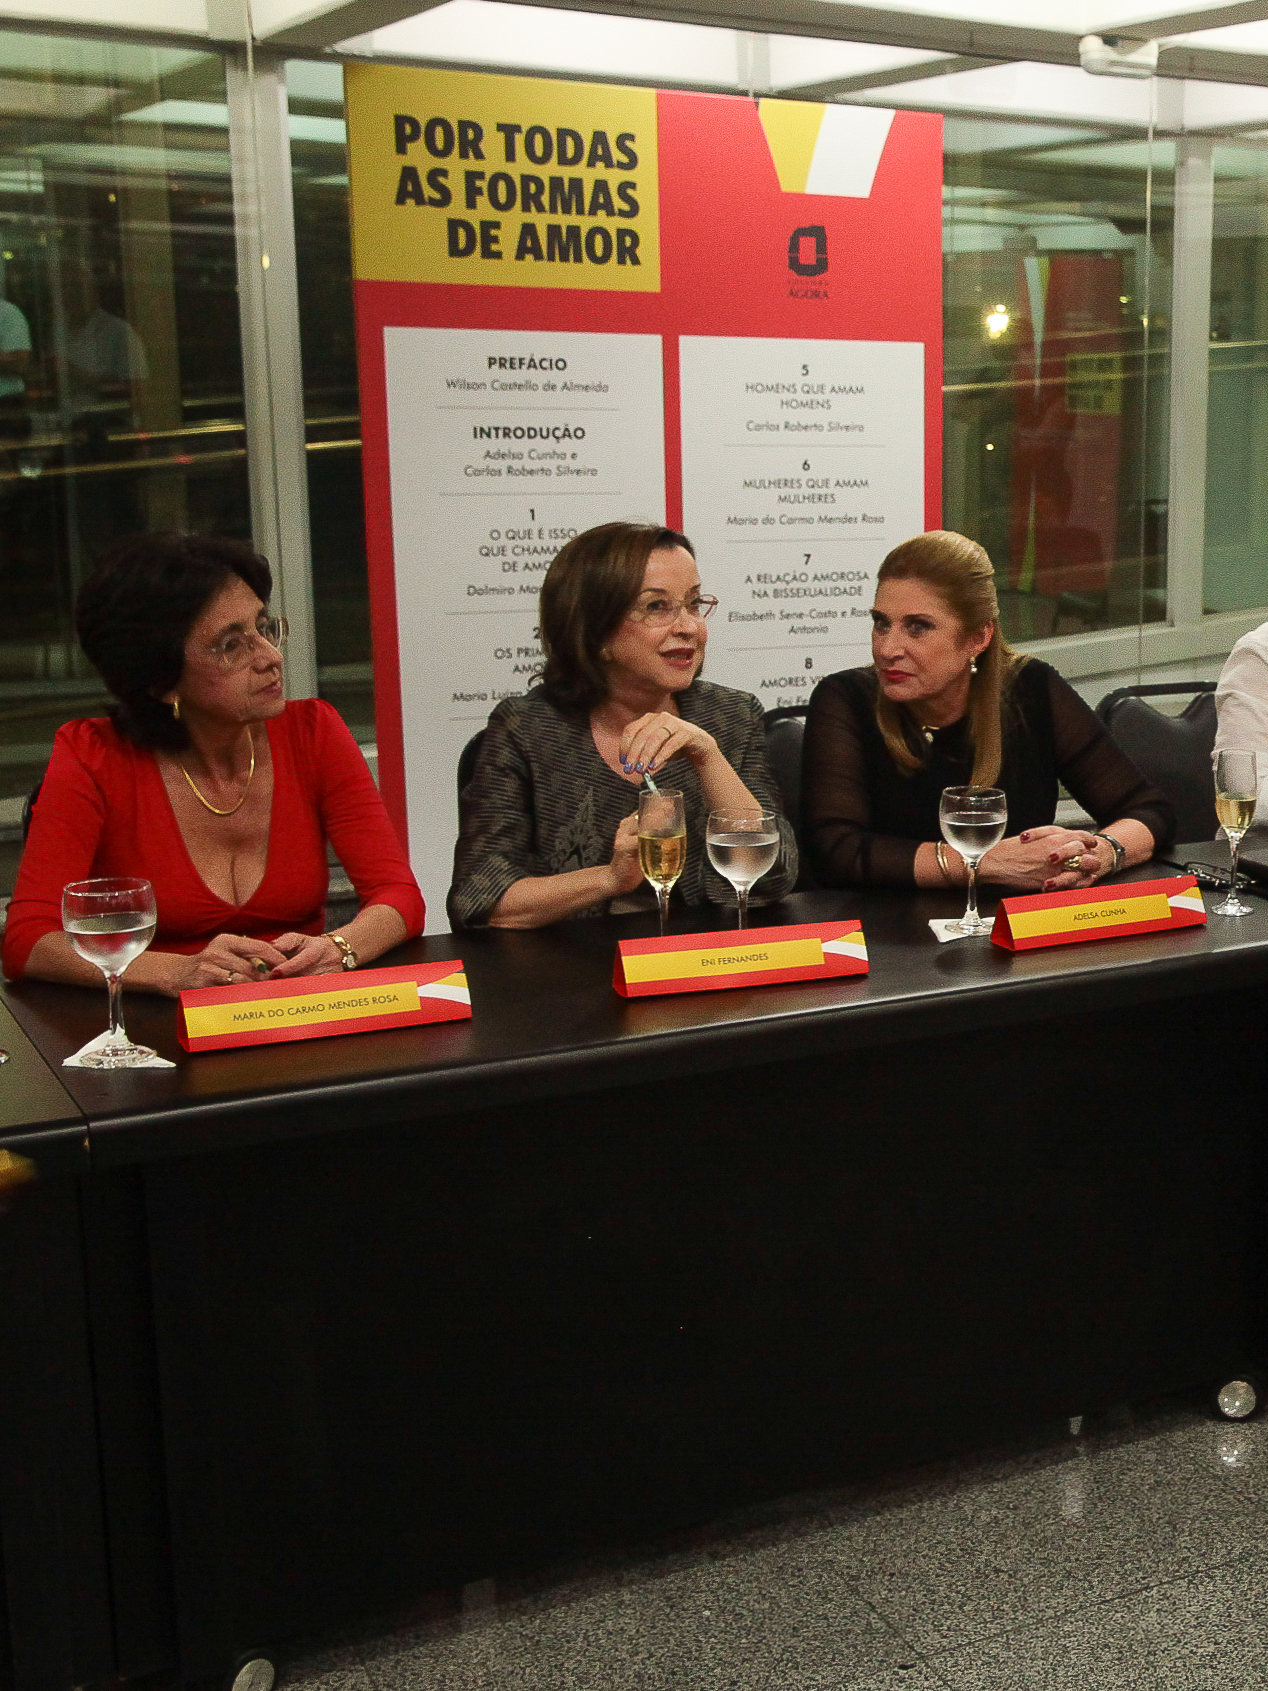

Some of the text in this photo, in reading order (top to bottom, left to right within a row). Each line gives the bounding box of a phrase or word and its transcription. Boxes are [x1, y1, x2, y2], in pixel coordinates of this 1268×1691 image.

[393, 113, 639, 171] POR TODAS
[394, 165, 640, 219] AS FORMAS
[446, 218, 641, 266] DE AMOR
[488, 354, 567, 370] PREFÁCIO
[801, 364, 809, 376] 5
[446, 378, 609, 393] Wilson Castello de Almeida
[745, 382, 865, 395] HOMENS QUE AMAM
[780, 399, 832, 411] HOMENS
[745, 420, 865, 432] Carlos Roberto Silveira
[473, 423, 586, 443] INTRODUÇÃO
[484, 448, 578, 461] Adelsa Cunha e
[464, 464, 598, 477] Carlos Roberto Silveira
[802, 459, 811, 471] 6
[743, 478, 869, 490] MULHERES QUE AMAM
[777, 493, 836, 505] MULHERES
[529, 508, 536, 521] 1
[727, 512, 885, 527] Maria do Carmo Mendes Rosa
[489, 529, 501, 541] O
[505, 528, 534, 541] QUE
[549, 528, 578, 540] ISSO
[479, 544, 564, 557] QUE CHAMA
[803, 553, 811, 565] 7
[502, 560, 552, 573] DE AMO
[745, 570, 870, 585] A RELAÇÃO AMOROSA
[467, 585, 515, 597] Dalmiro
[752, 585, 864, 599] NA BISSEXUALIDADE
[728, 610, 776, 622] Elisabeth
[841, 610, 848, 618] e
[533, 626, 541, 640] 2
[494, 648, 513, 660] OS
[512, 662, 546, 674] AMO
[804, 657, 813, 669] 8
[760, 675, 807, 689] AMORES
[451, 691, 488, 702] Maria
[1073, 908, 1127, 922] ADELSA CUNHA
[701, 952, 769, 967] ENI FERNANDES
[232, 994, 400, 1023] MARIA DO CARMO MENDES ROSA
